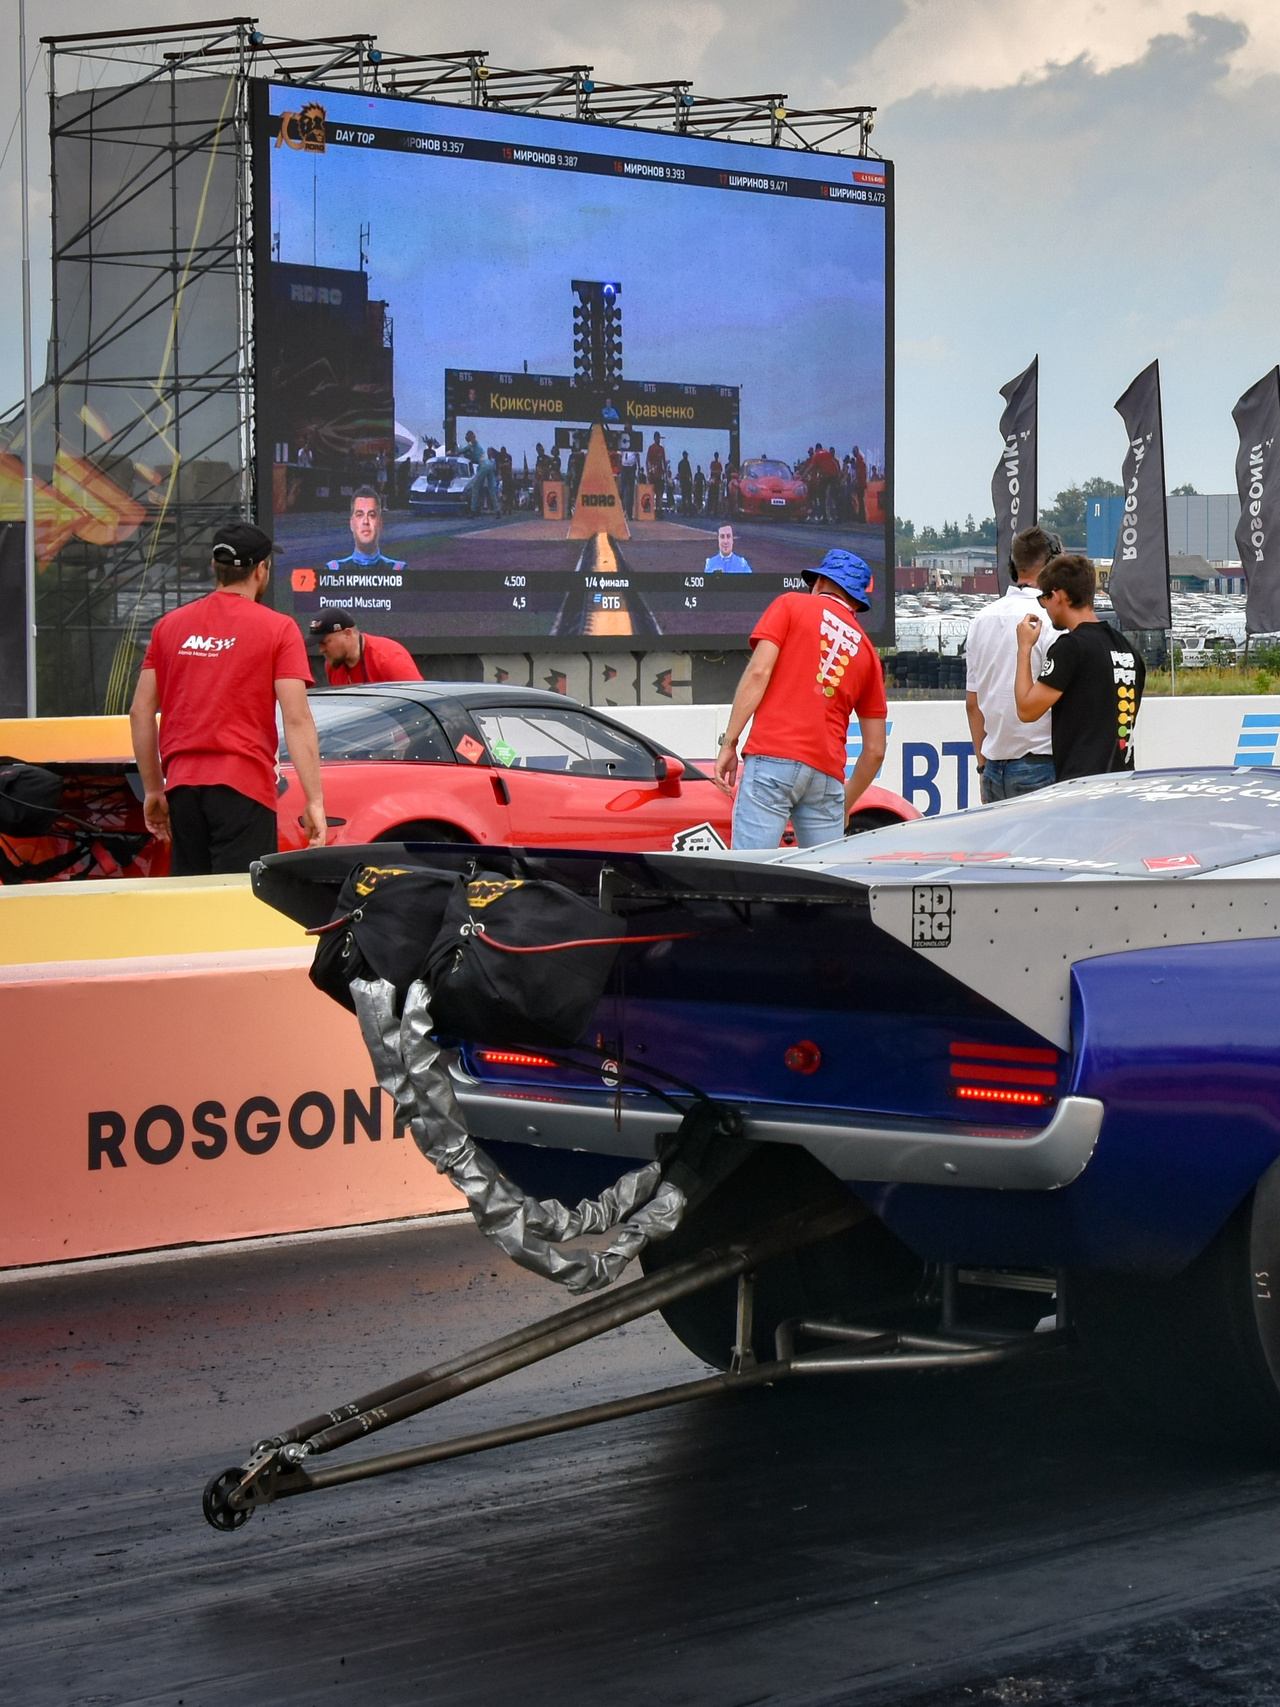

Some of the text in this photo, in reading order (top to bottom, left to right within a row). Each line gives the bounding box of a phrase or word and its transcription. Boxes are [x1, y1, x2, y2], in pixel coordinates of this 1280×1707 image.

[335, 129, 375, 145] DAY TOP
[402, 137, 465, 154] ИРОНОВ 9.357
[502, 148, 578, 167] 15 МИРОНОВ 9.387
[613, 161, 685, 180] 16 МИРОНОВ 9.393
[719, 174, 788, 192] 17 ШИРИНОВ 9.471
[829, 187, 867, 201] ШИРИНОВ
[867, 192, 886, 204] 9.473
[459, 371, 473, 382] ВТБ
[499, 374, 513, 385] ВТБ
[490, 392, 563, 414] Криксунов
[626, 400, 695, 420] Кравченко
[300, 575, 526, 588] 7 ИЛЬЯ КРИКСУНОВ 4.500
[584, 576, 629, 590] 1/4 финала
[684, 577, 704, 588] 4.500
[319, 597, 392, 610] Promod Mustang
[512, 597, 526, 609] 4,5
[601, 596, 621, 609] ВТБ
[684, 597, 697, 609] 4,5
[902, 742, 975, 817] ВТ
[912, 940, 951, 948] TECHNOLOGY
